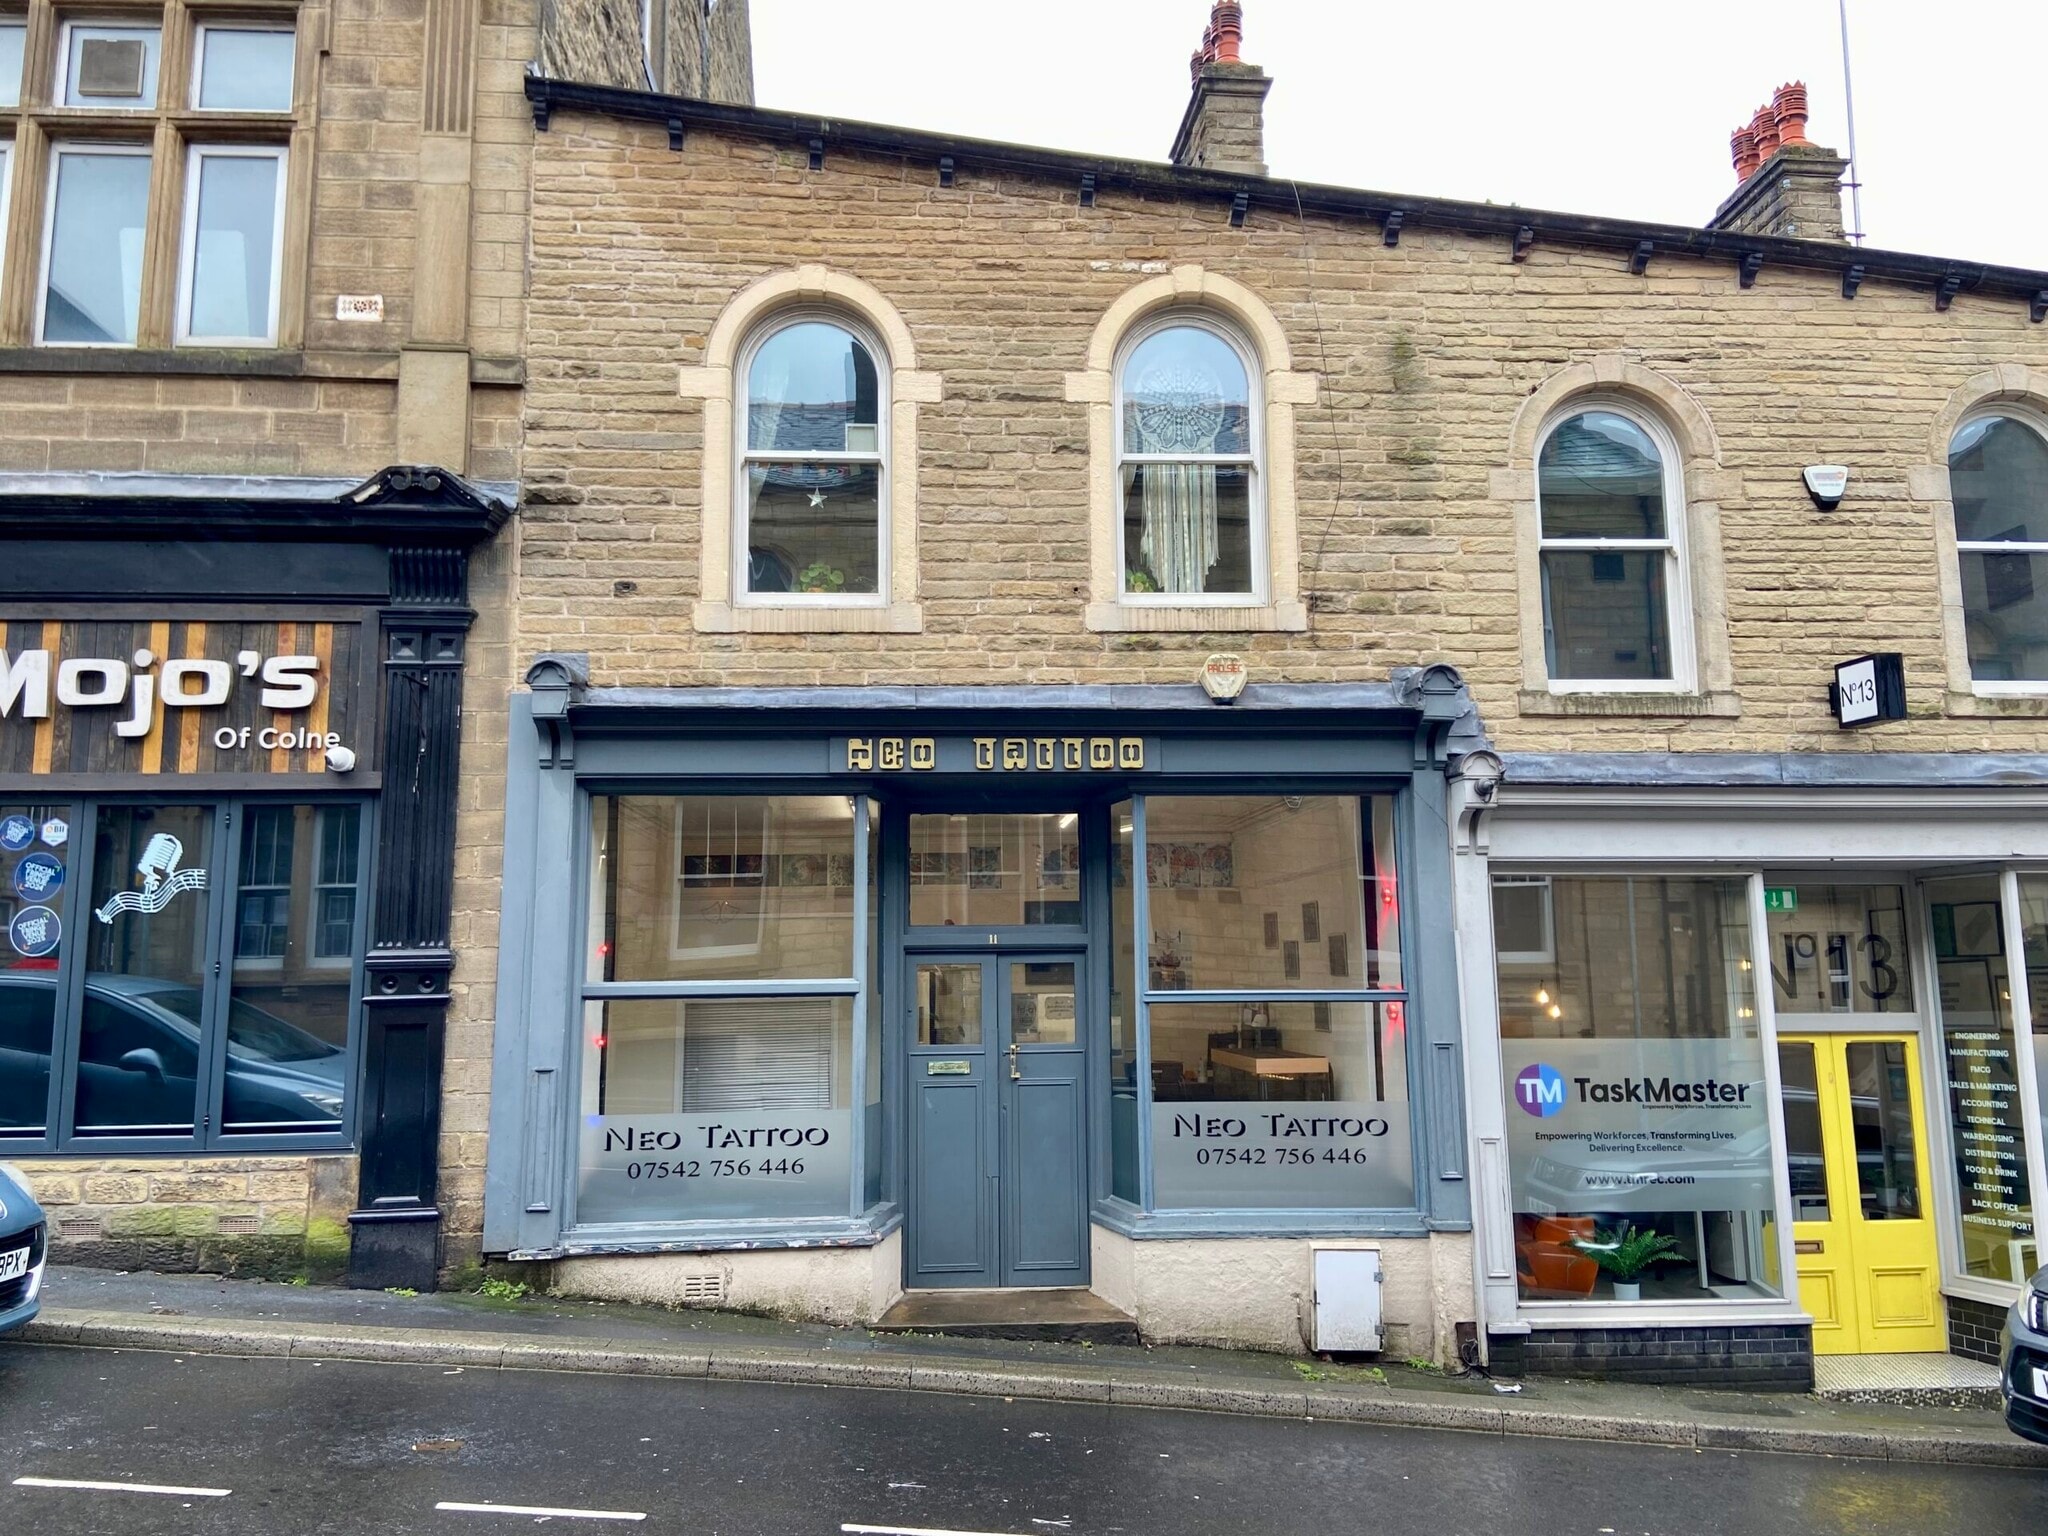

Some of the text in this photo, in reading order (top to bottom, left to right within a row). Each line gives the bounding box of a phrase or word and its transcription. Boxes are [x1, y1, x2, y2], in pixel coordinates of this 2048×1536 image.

[0, 648, 321, 737] Mojo's
[214, 726, 341, 750] Of Colne
[1955, 1032, 2000, 1040] ENGINEERING
[1949, 1048, 2009, 1058] MANUFACTURING
[1970, 1065, 1991, 1074] FMCG
[1519, 1078, 1563, 1104] TM
[1574, 1077, 1750, 1103] TaskMaster
[1949, 1081, 1970, 1090] SALES
[1976, 1082, 2018, 1092] MARKETING
[1961, 1099, 2008, 1109] ACCOUNTING
[1967, 1115, 2006, 1126] TECHNICAL
[1535, 1131, 1737, 1141] Empowering Workforces, Transforming Lives,
[1962, 1132, 2014, 1143] WAREHOUSING
[1589, 1143, 1685, 1153] Delivering Excellence.
[1965, 1148, 2015, 1160] DISTRIBUTION
[1197, 1148, 1367, 1165] 07542 756 446
[627, 1157, 805, 1179] 07542 756 446
[1965, 1165, 1986, 1174] FOOD
[1995, 1168, 2018, 1178] DRINK
[1973, 1182, 2013, 1194] EXECUTIVE
[1972, 1199, 2019, 1212] BACK OFFICE
[1963, 1214, 2032, 1231] BUSINESS SUPPORT
